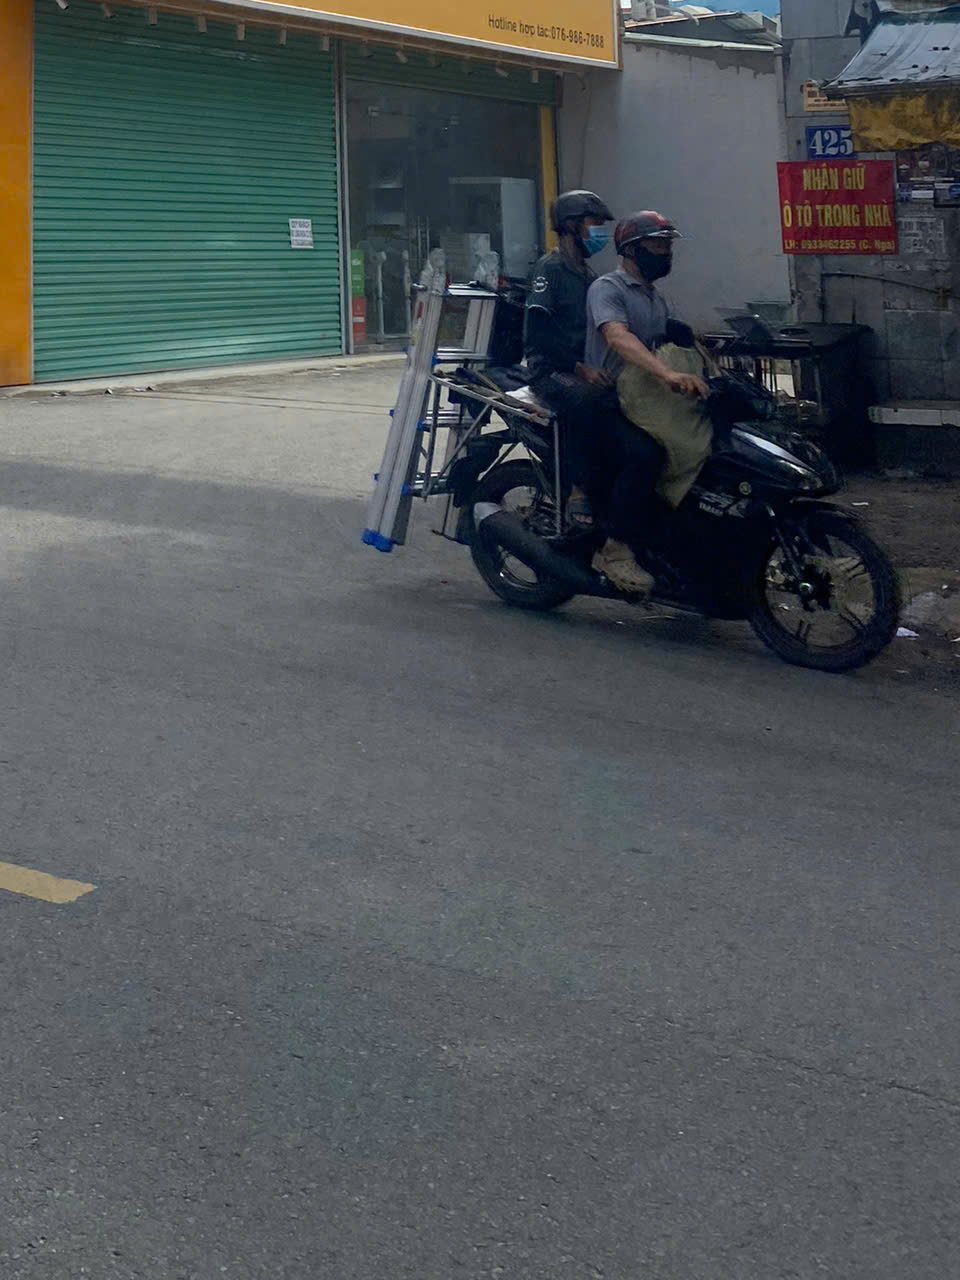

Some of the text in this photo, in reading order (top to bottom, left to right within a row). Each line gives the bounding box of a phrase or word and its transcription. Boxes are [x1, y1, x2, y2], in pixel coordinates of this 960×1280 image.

[488, 14, 517, 32] Hotline
[809, 129, 854, 156] 425
[802, 162, 865, 195] NHẬN GIỮ
[783, 200, 892, 227] Ô TÔ TRONG NHÀ
[874, 239, 896, 251] Nga)
